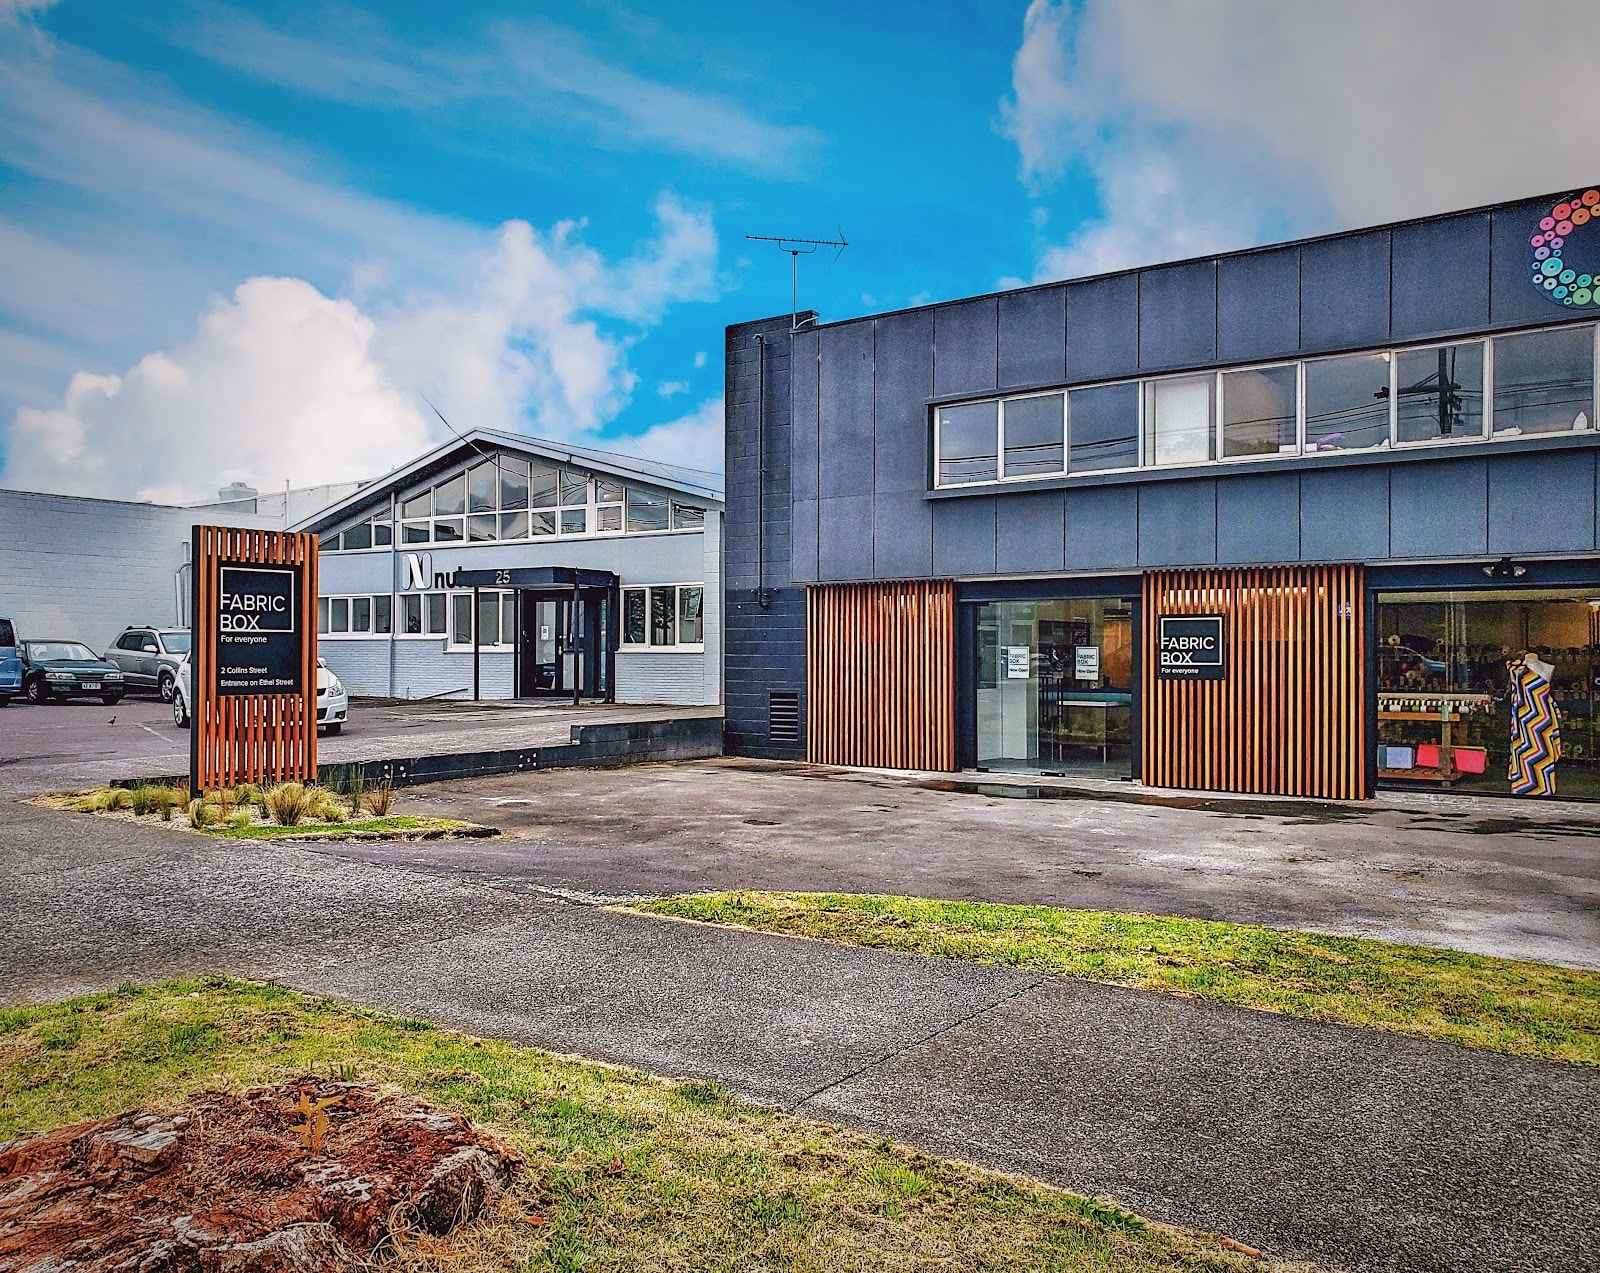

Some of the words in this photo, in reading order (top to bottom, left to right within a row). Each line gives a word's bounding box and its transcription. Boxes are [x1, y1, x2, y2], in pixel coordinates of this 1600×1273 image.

[495, 570, 511, 585] 25
[220, 593, 286, 612] FABRIC
[220, 614, 261, 631] BOX
[220, 635, 233, 643] For
[234, 636, 267, 645] everyone
[1161, 636, 1215, 650] FABRIC
[1161, 652, 1194, 665] BOX
[226, 666, 248, 674] Collins
[248, 666, 268, 674] Street
[220, 679, 249, 687] Entrance
[259, 678, 275, 686] Ethel
[275, 678, 294, 686] Street
